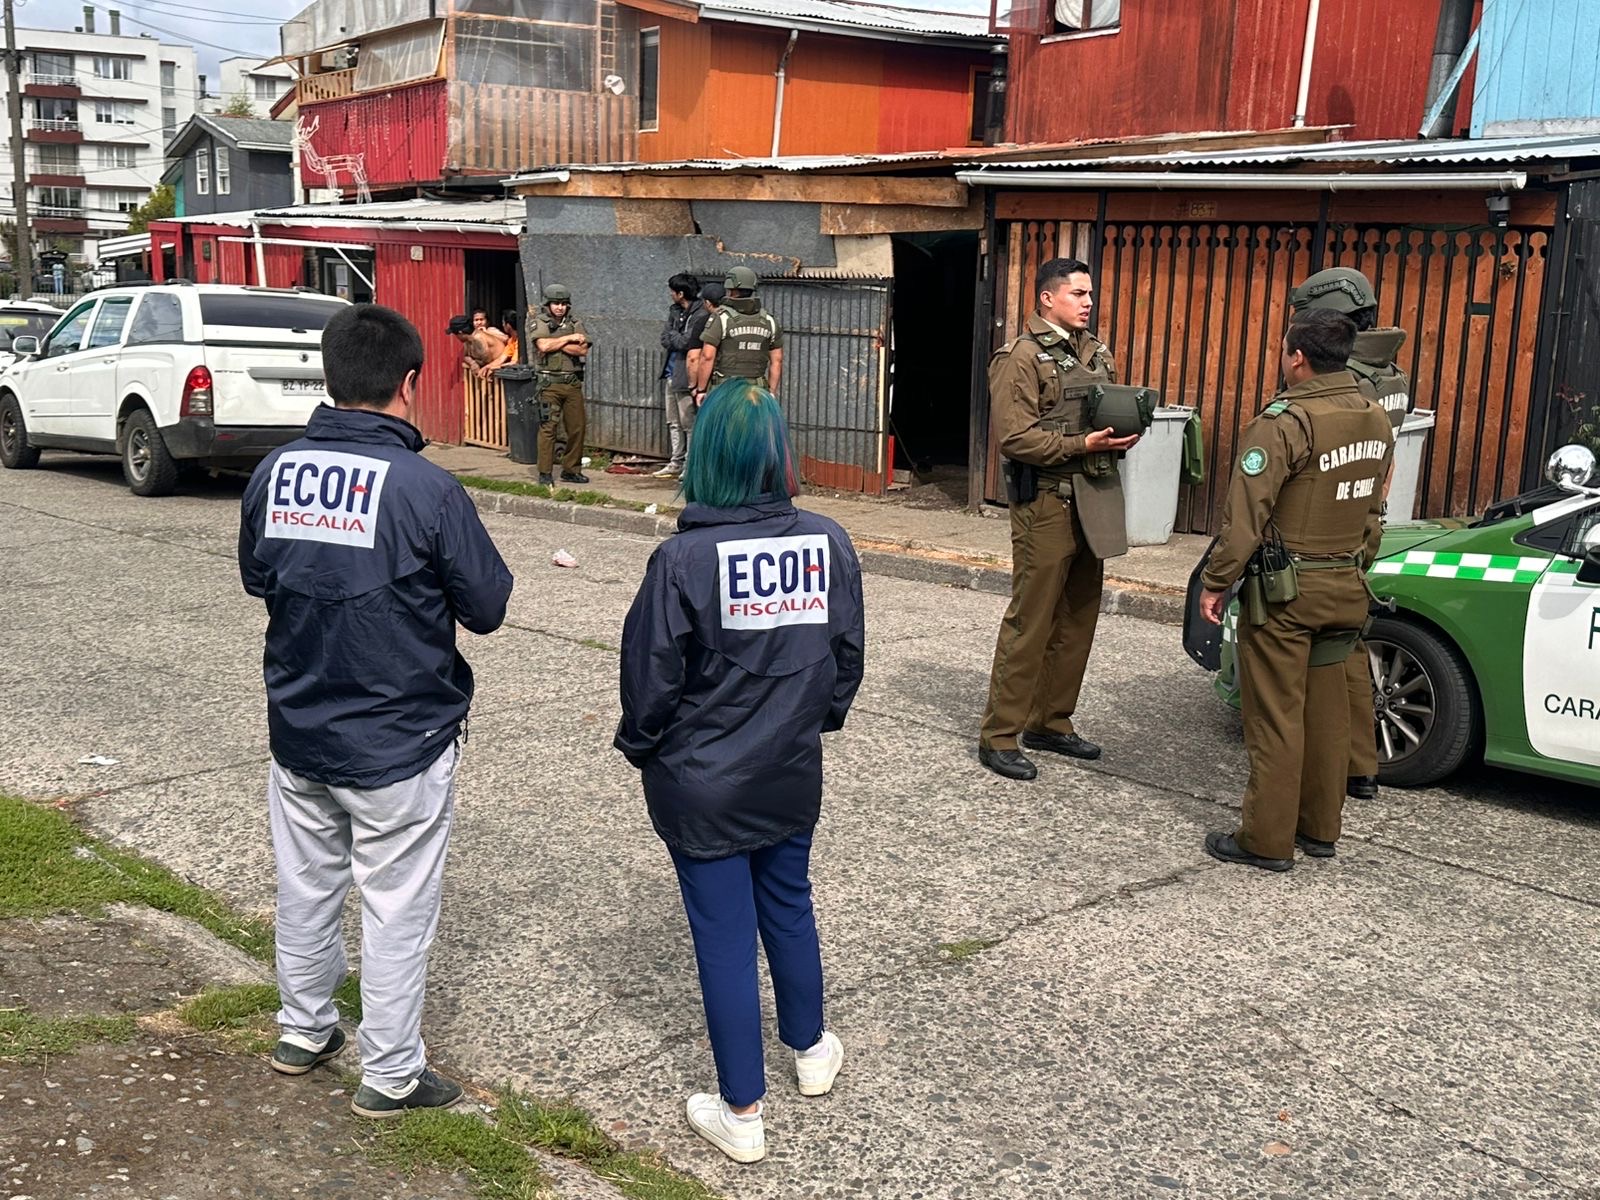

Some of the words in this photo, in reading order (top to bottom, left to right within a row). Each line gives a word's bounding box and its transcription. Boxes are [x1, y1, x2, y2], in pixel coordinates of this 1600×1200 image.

[738, 341, 747, 350] DE
[274, 462, 377, 515] ECOH
[1335, 481, 1351, 500] DE
[1352, 477, 1376, 499] CHILE
[271, 511, 366, 533] FISCALIA
[728, 548, 826, 600] ECOH
[729, 597, 825, 617] FISCALIA
